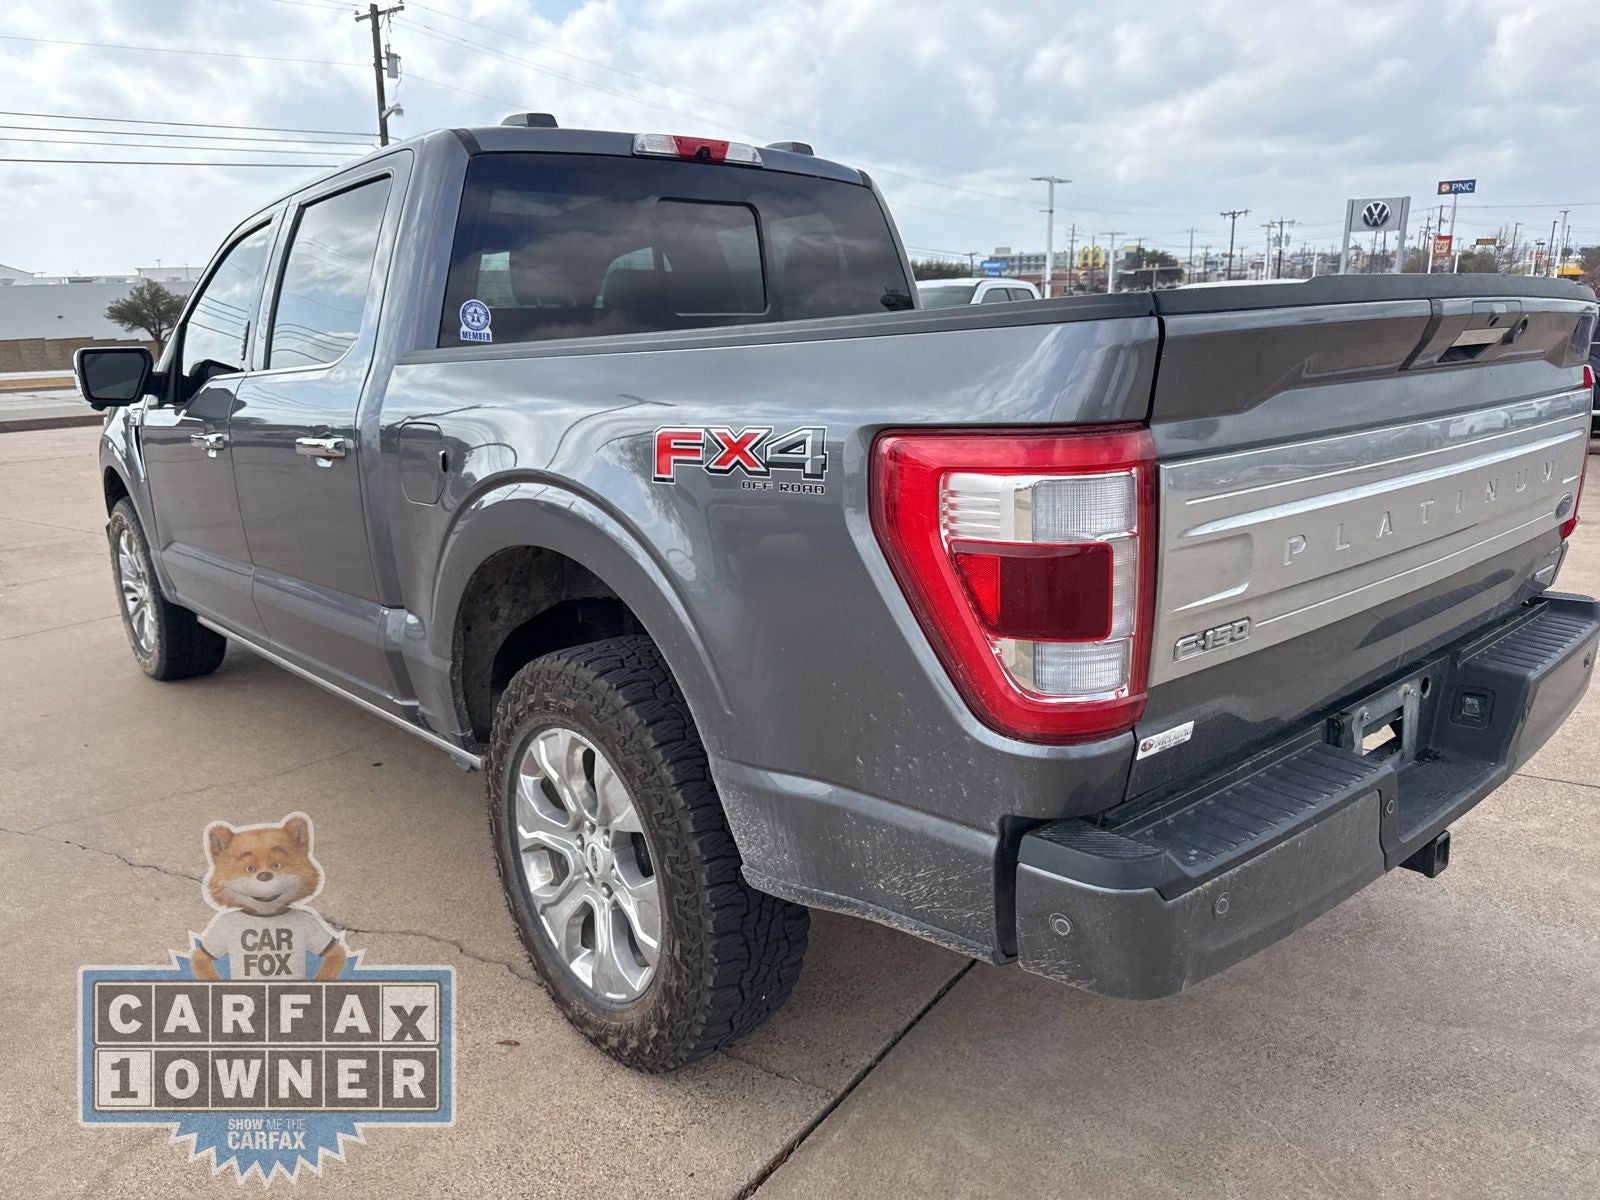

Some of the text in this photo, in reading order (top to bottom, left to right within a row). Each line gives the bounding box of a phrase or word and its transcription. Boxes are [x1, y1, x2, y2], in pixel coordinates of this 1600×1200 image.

[1451, 182, 1474, 192] PNC
[462, 331, 490, 341] MEMBER
[652, 425, 828, 484] FX4
[742, 480, 825, 495] OFF ROAD
[1283, 460, 1556, 566] PLATINUM
[1173, 616, 1251, 663] F-150
